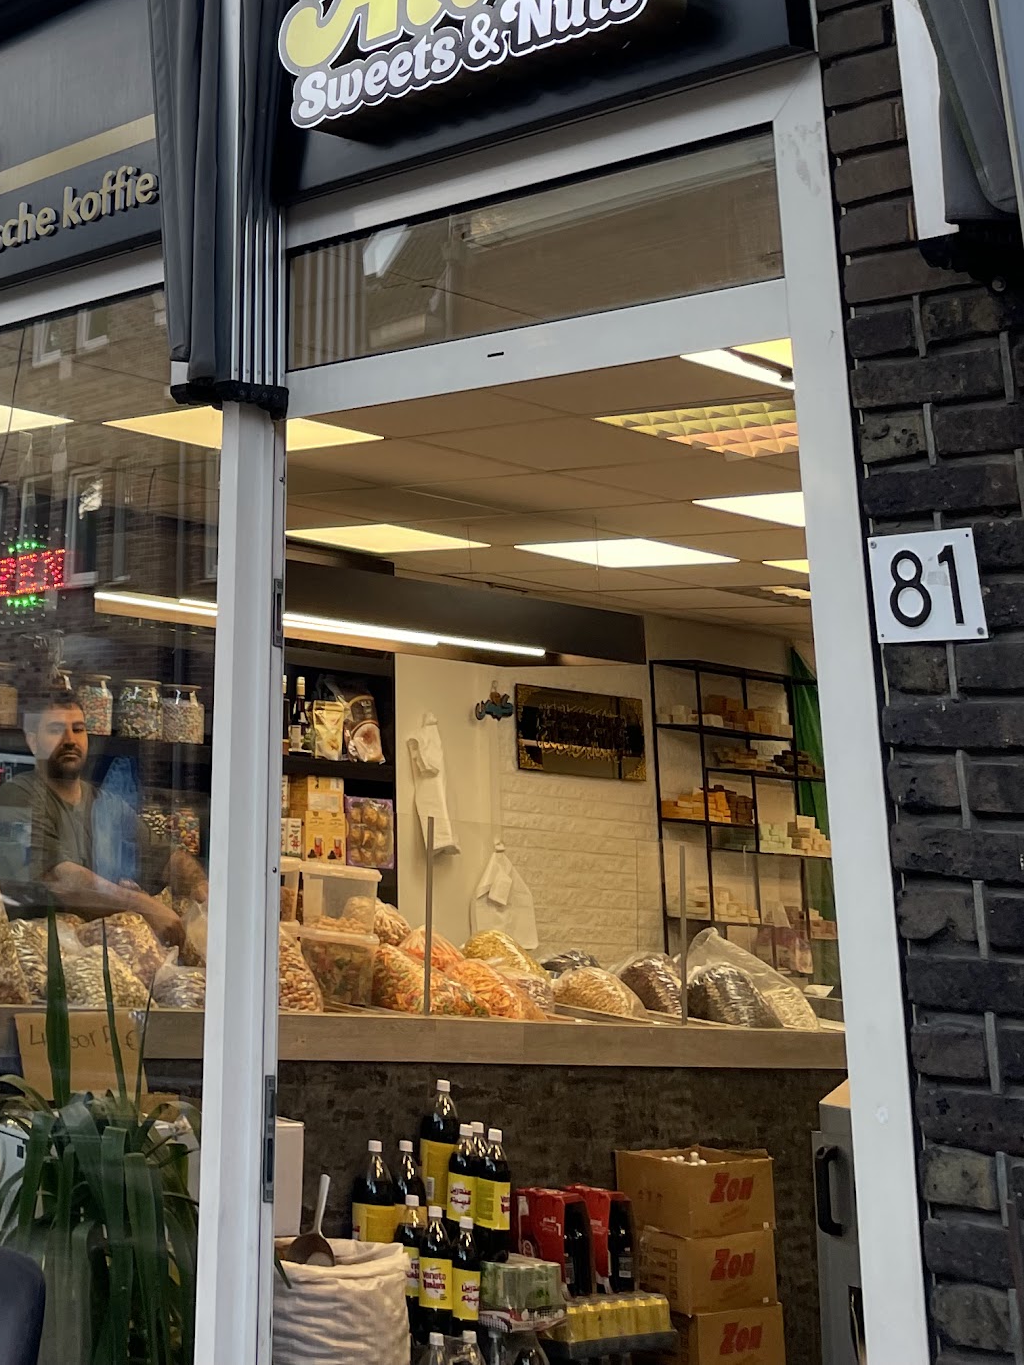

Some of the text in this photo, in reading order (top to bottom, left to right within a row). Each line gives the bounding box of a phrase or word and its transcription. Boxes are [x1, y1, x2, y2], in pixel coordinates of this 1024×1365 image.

[297, 34, 456, 119] Sweets
[467, 14, 502, 60] &
[62, 166, 159, 230] koffie
[890, 545, 964, 627] 81
